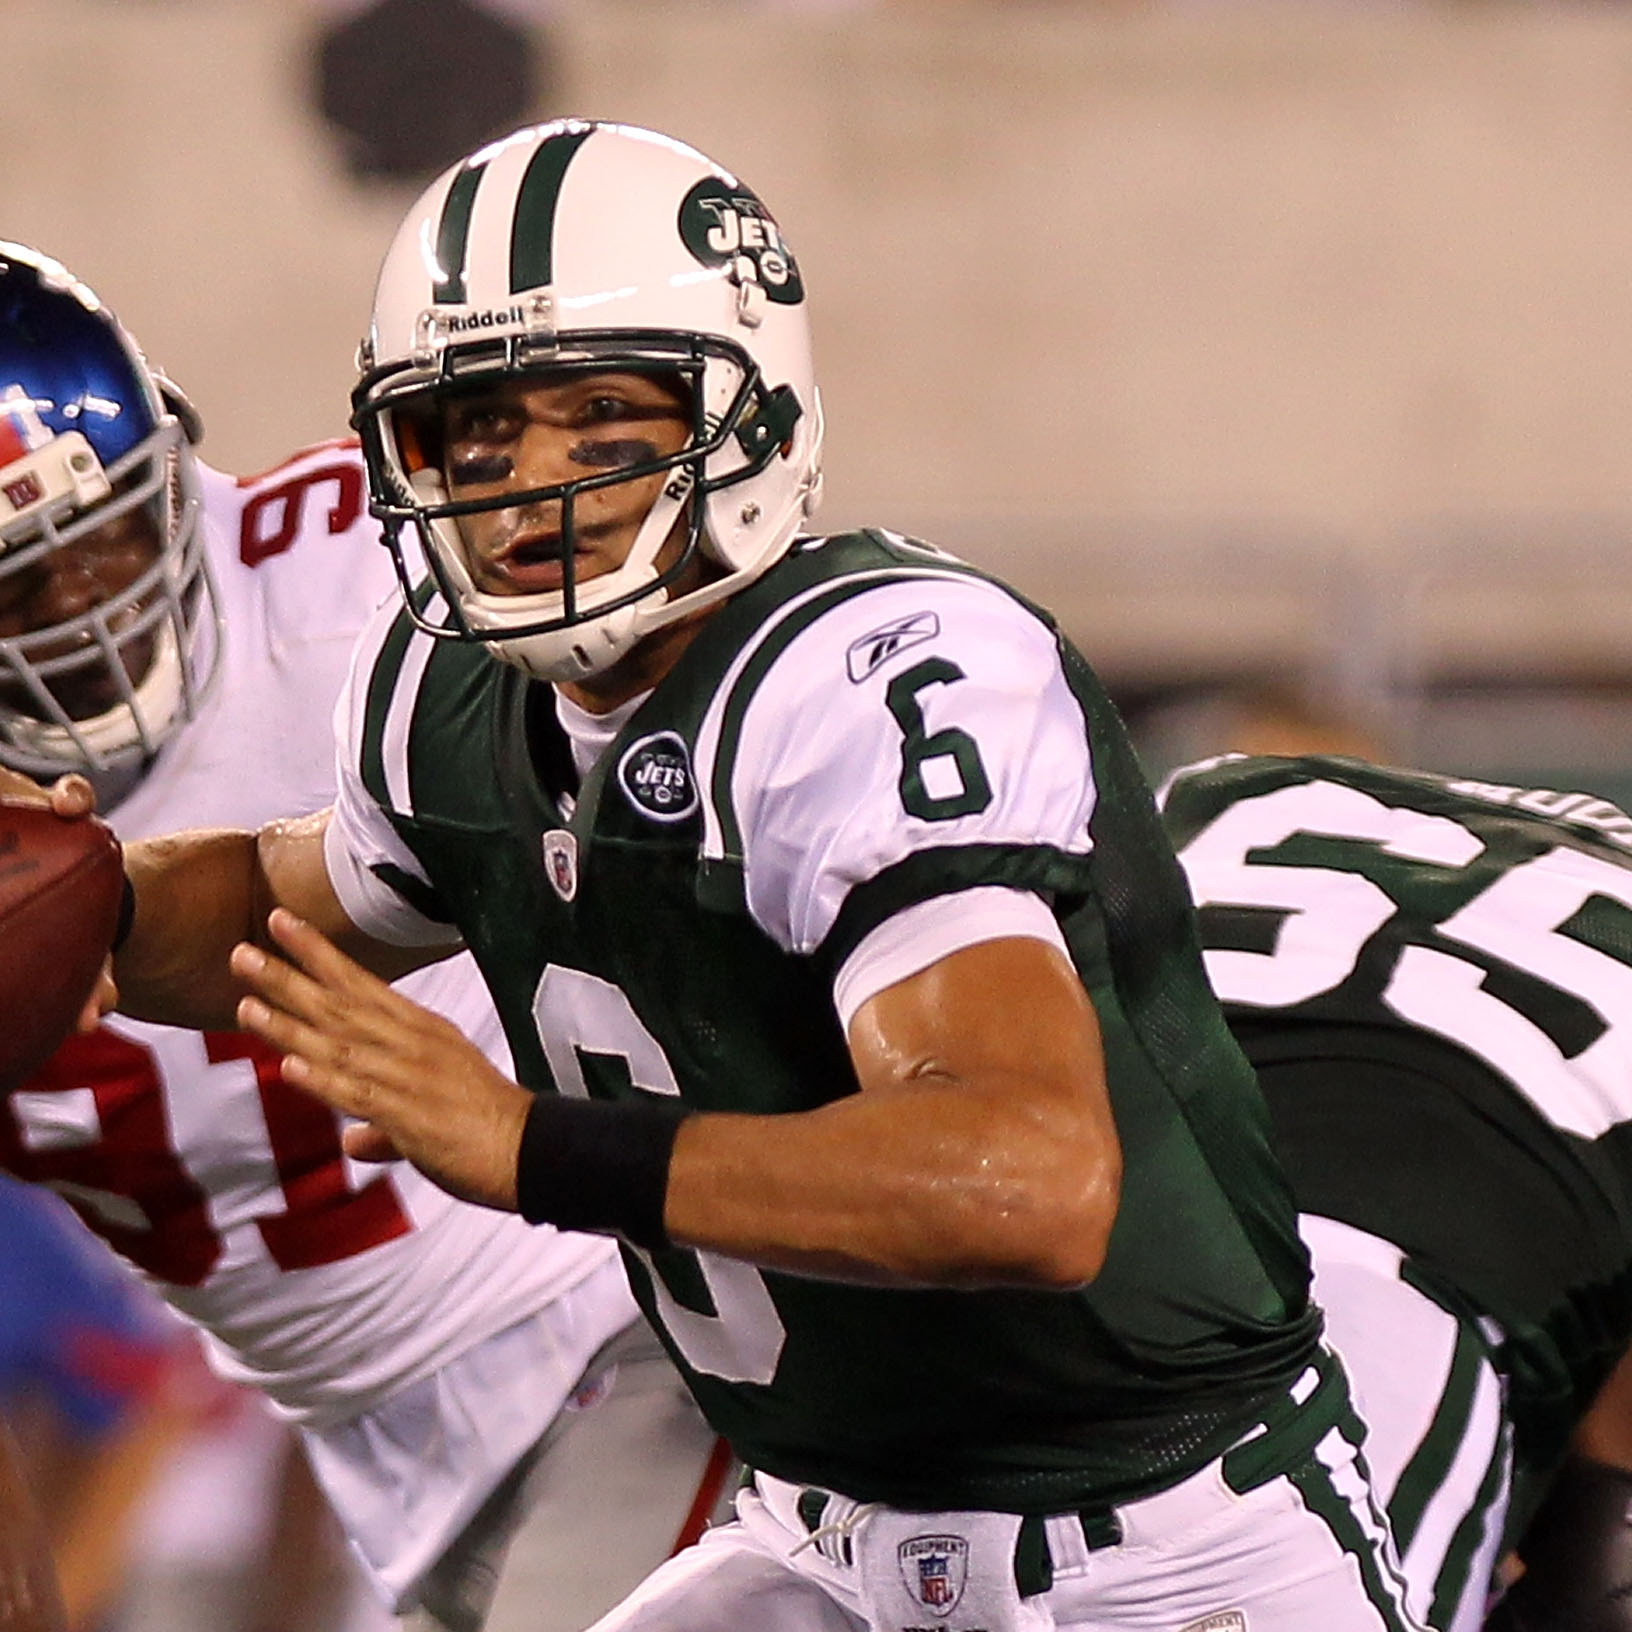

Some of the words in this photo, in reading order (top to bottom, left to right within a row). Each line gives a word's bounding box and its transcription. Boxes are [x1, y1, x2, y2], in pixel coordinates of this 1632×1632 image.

[448, 304, 524, 333] Riddell
[885, 656, 992, 822] 6
[635, 760, 686, 787] JETS
